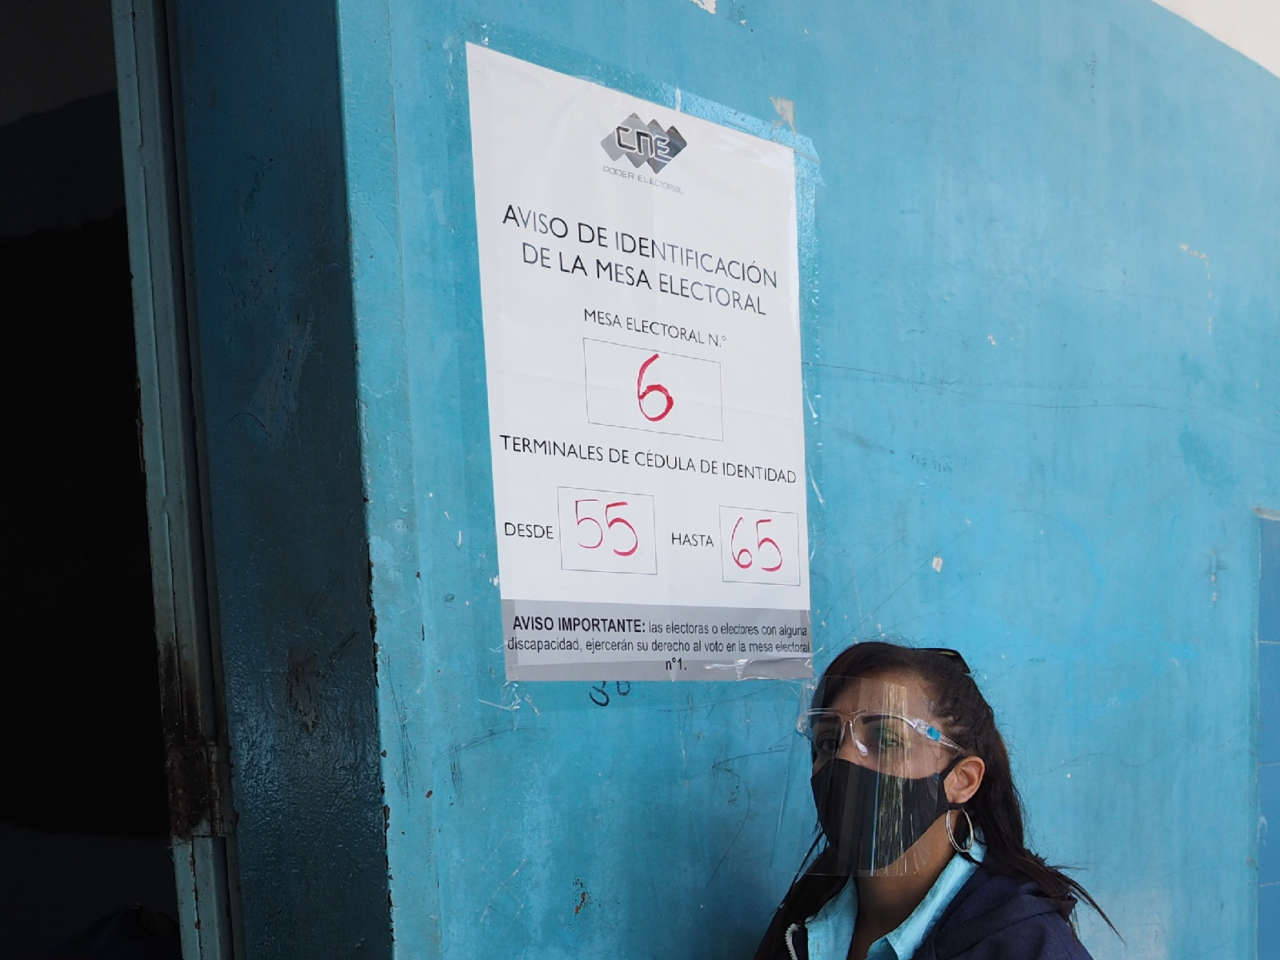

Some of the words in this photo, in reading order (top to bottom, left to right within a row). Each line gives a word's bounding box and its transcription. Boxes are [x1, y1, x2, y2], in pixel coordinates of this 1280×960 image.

[502, 204, 569, 238] AVISO
[577, 222, 609, 248] DE
[615, 231, 778, 289] IDENTIFICACIÓN
[522, 242, 552, 269] DE
[559, 251, 588, 277] LA
[596, 258, 652, 290] MESA
[658, 272, 767, 316] ELECTORAL
[583, 308, 622, 329] MESA
[626, 316, 705, 345] ELECTORAL
[637, 353, 675, 422] 6
[499, 434, 604, 462] TERMINALES
[608, 447, 630, 465] DE
[634, 449, 697, 473] CÉDULA
[700, 459, 719, 475] DE
[722, 461, 797, 484] IDENTIDAD
[503, 521, 555, 540] DESDE
[575, 498, 639, 557] 55
[671, 532, 715, 548] HASTA
[730, 516, 783, 573] 65
[512, 615, 554, 632] AVISO
[558, 616, 646, 634] IMPORTANTE:
[649, 620, 663, 634] las
[665, 621, 709, 636] electoras
[711, 624, 719, 636] o
[720, 621, 760, 636] electores
[761, 625, 777, 636] con
[778, 622, 808, 639] alguna
[585, 638, 634, 655] ejercerán
[637, 641, 649, 652] su
[651, 639, 691, 652] derecho
[693, 640, 702, 652] al
[703, 641, 724, 652] voto
[726, 643, 736, 653] en
[738, 640, 747, 653] la
[749, 643, 773, 653] mesa
[774, 641, 811, 654] electoral
